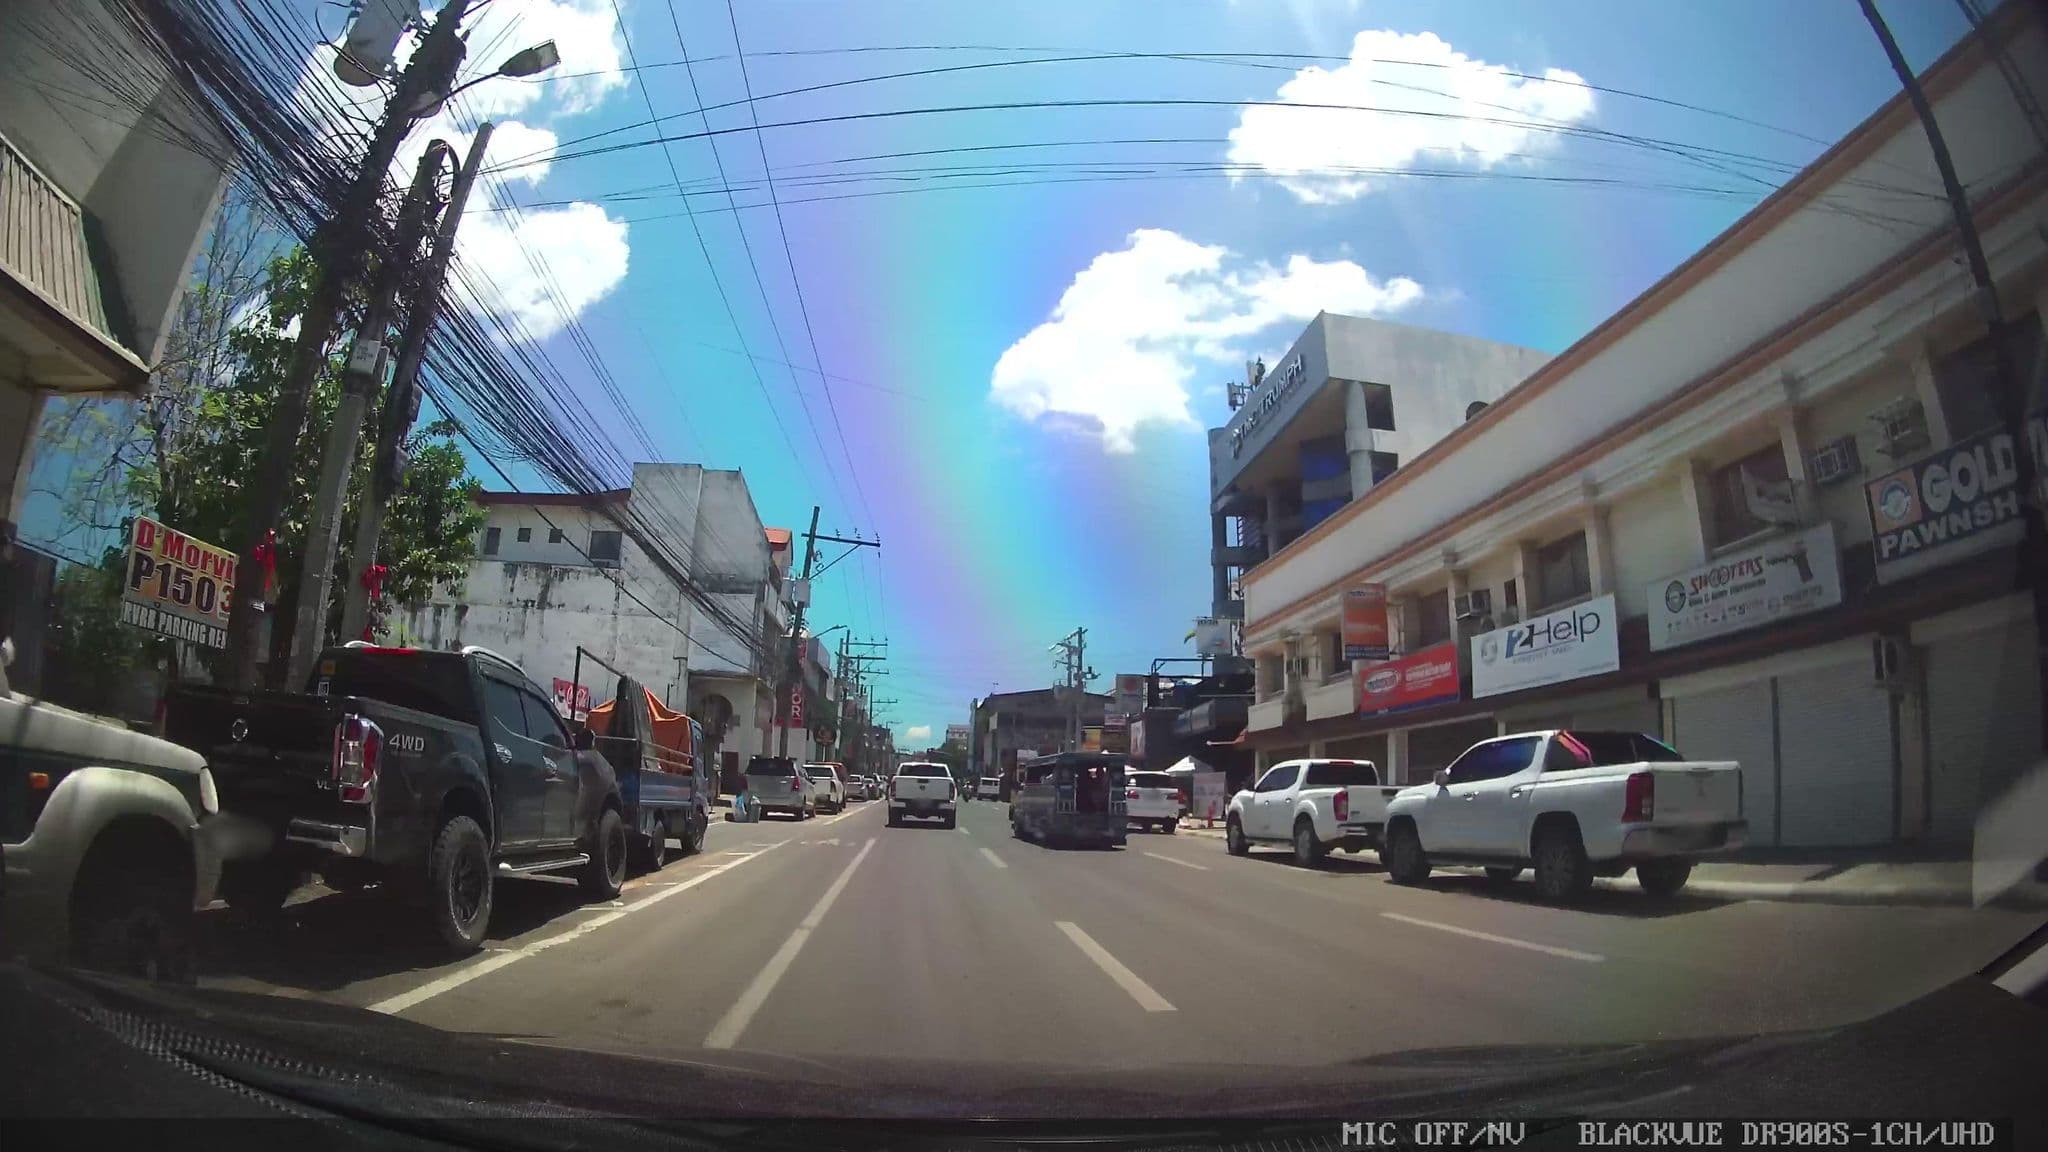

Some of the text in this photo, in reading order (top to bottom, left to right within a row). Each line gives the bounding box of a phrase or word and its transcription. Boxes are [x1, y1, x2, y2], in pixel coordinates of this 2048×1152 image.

[1921, 433, 2018, 513] GOLD
[1689, 556, 1764, 597] SHOOTERS
[158, 612, 206, 644] PARKING
[389, 733, 425, 752] 4WD
